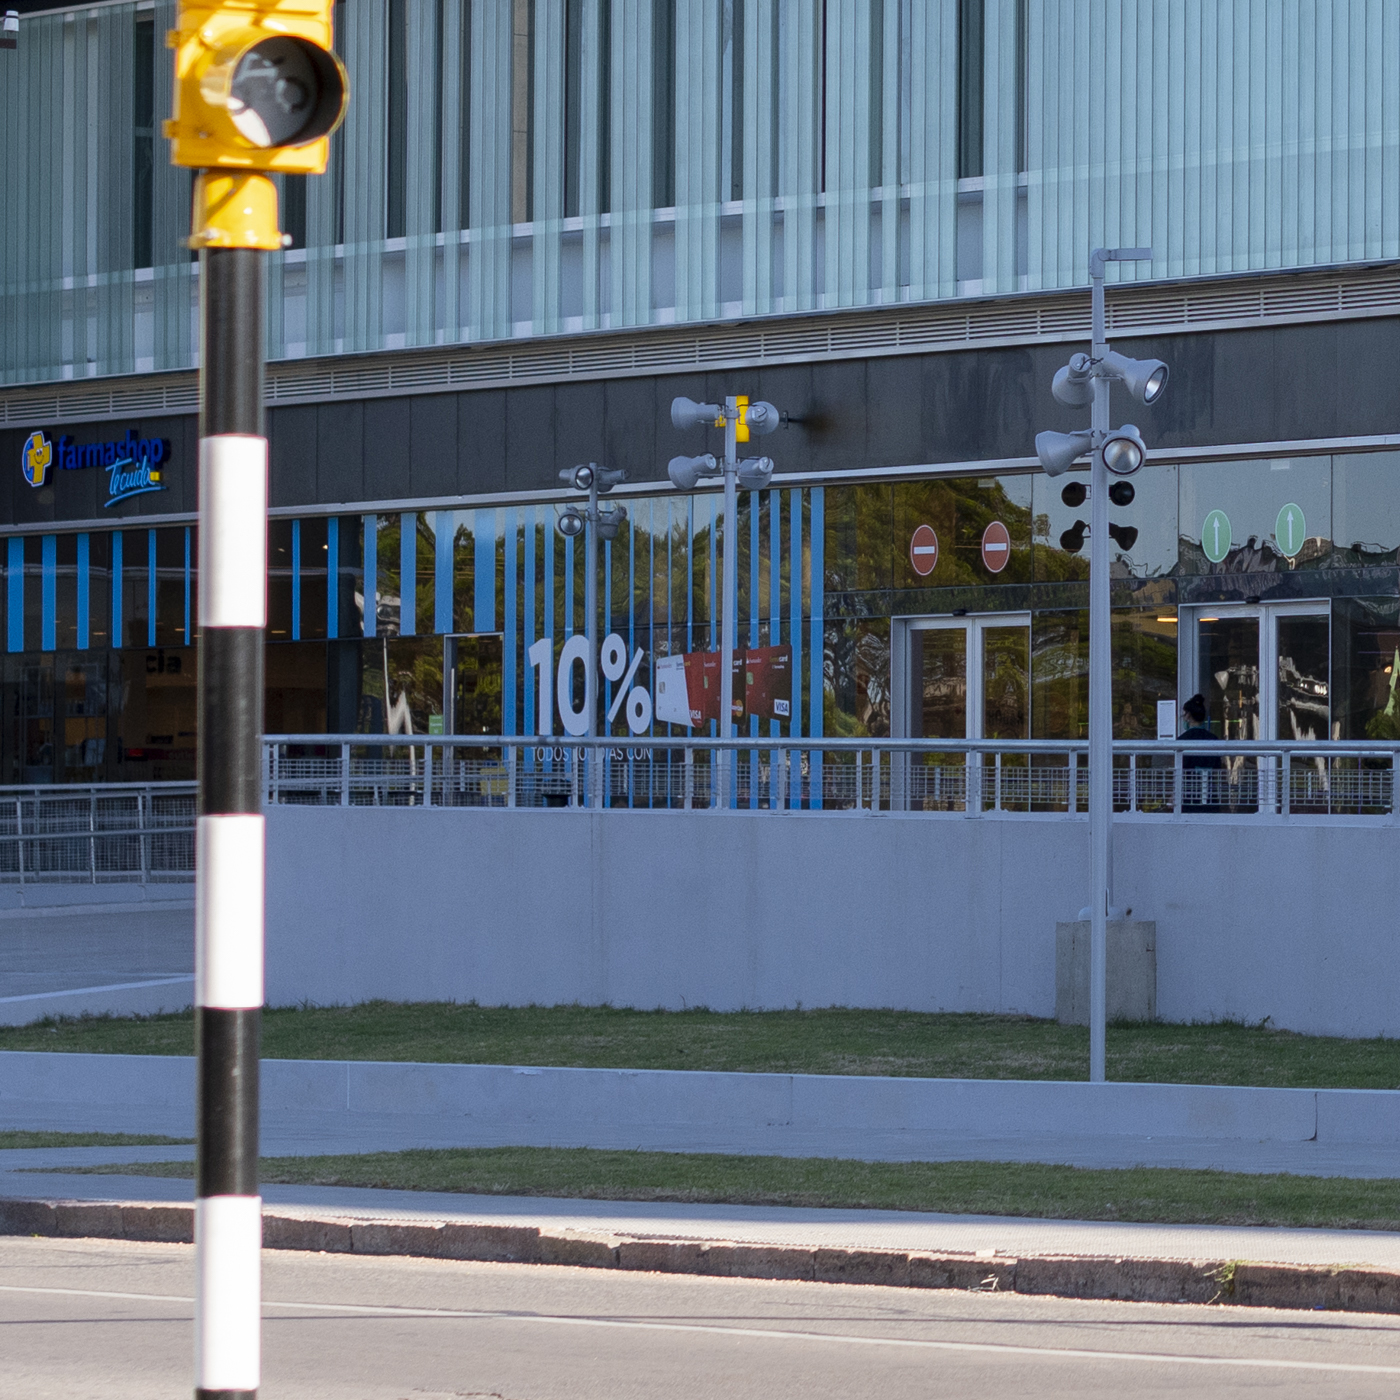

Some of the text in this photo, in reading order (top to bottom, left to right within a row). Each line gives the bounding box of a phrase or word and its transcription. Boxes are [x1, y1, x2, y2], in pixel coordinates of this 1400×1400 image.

[57, 429, 165, 472] farmashop
[528, 632, 652, 737] 10%
[775, 702, 788, 713] VISA
[531, 746, 570, 762] TODOS
[626, 746, 651, 761] CON
